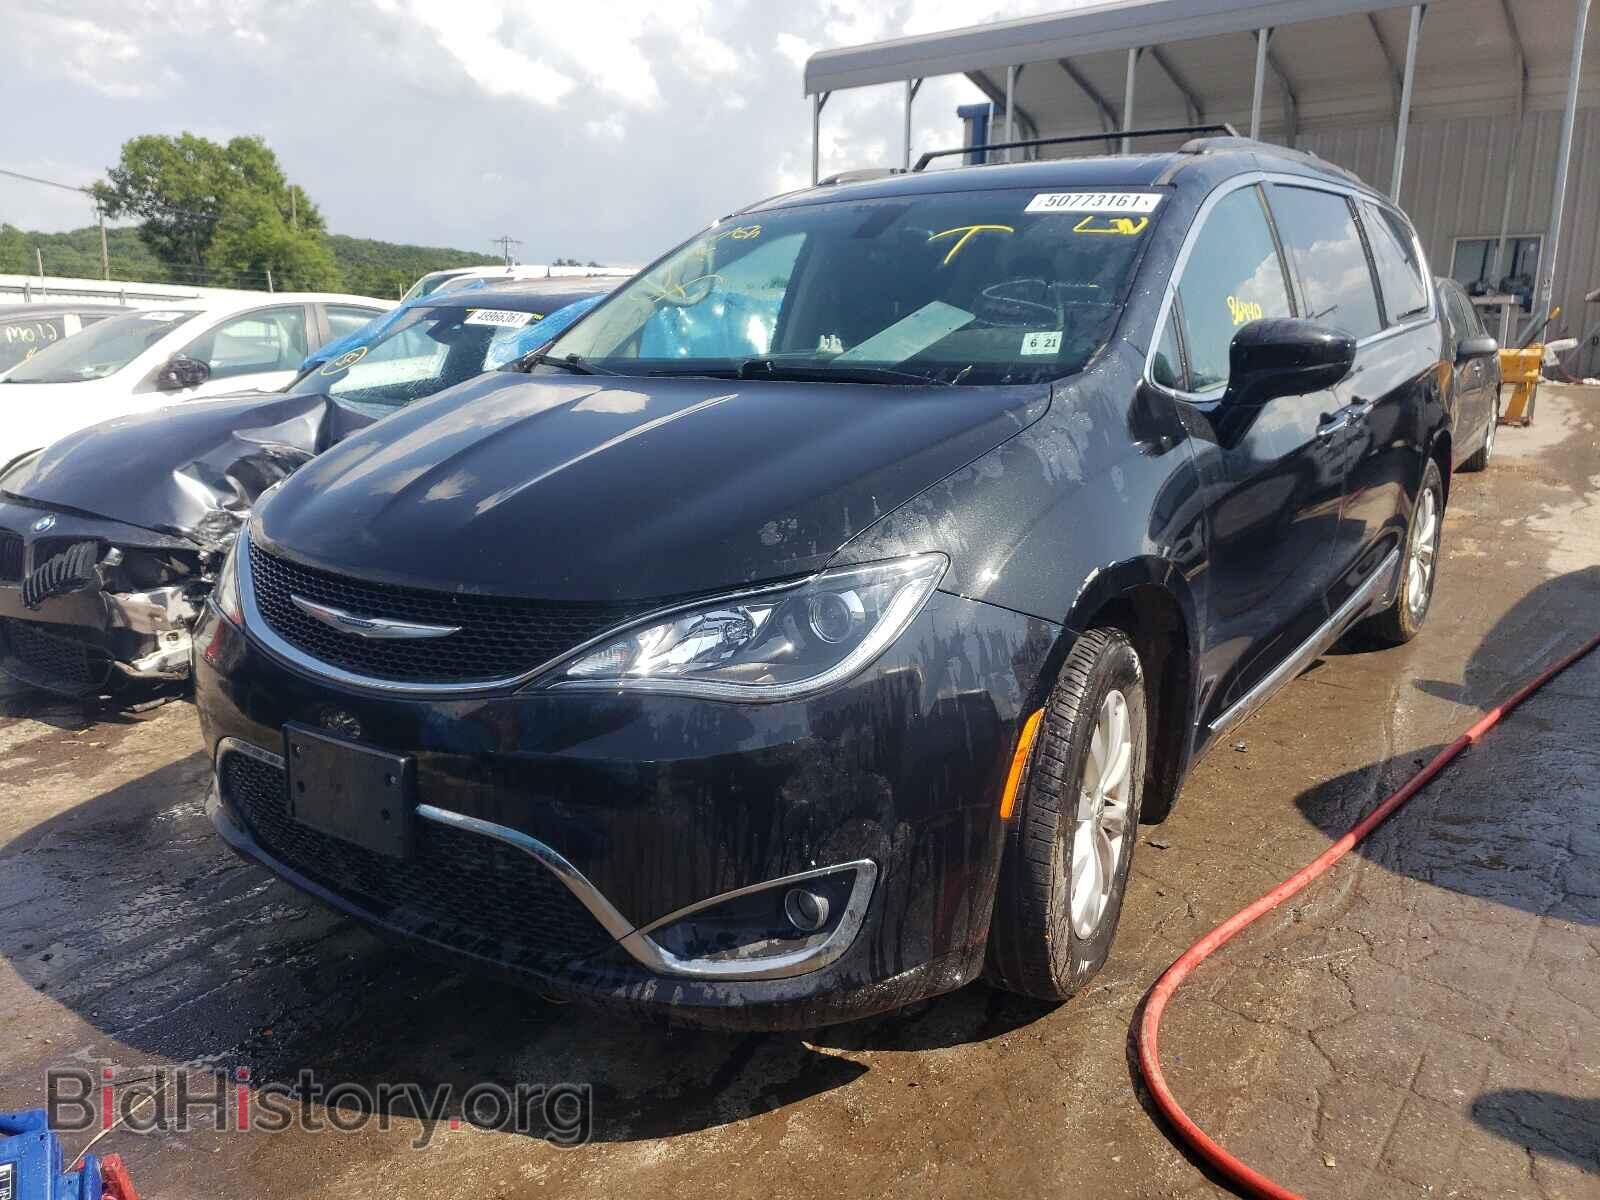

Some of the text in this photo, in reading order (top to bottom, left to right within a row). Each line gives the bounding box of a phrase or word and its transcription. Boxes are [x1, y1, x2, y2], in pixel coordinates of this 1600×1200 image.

[1044, 194, 1141, 208] 50773161
[1030, 338, 1057, 348] 6 21
